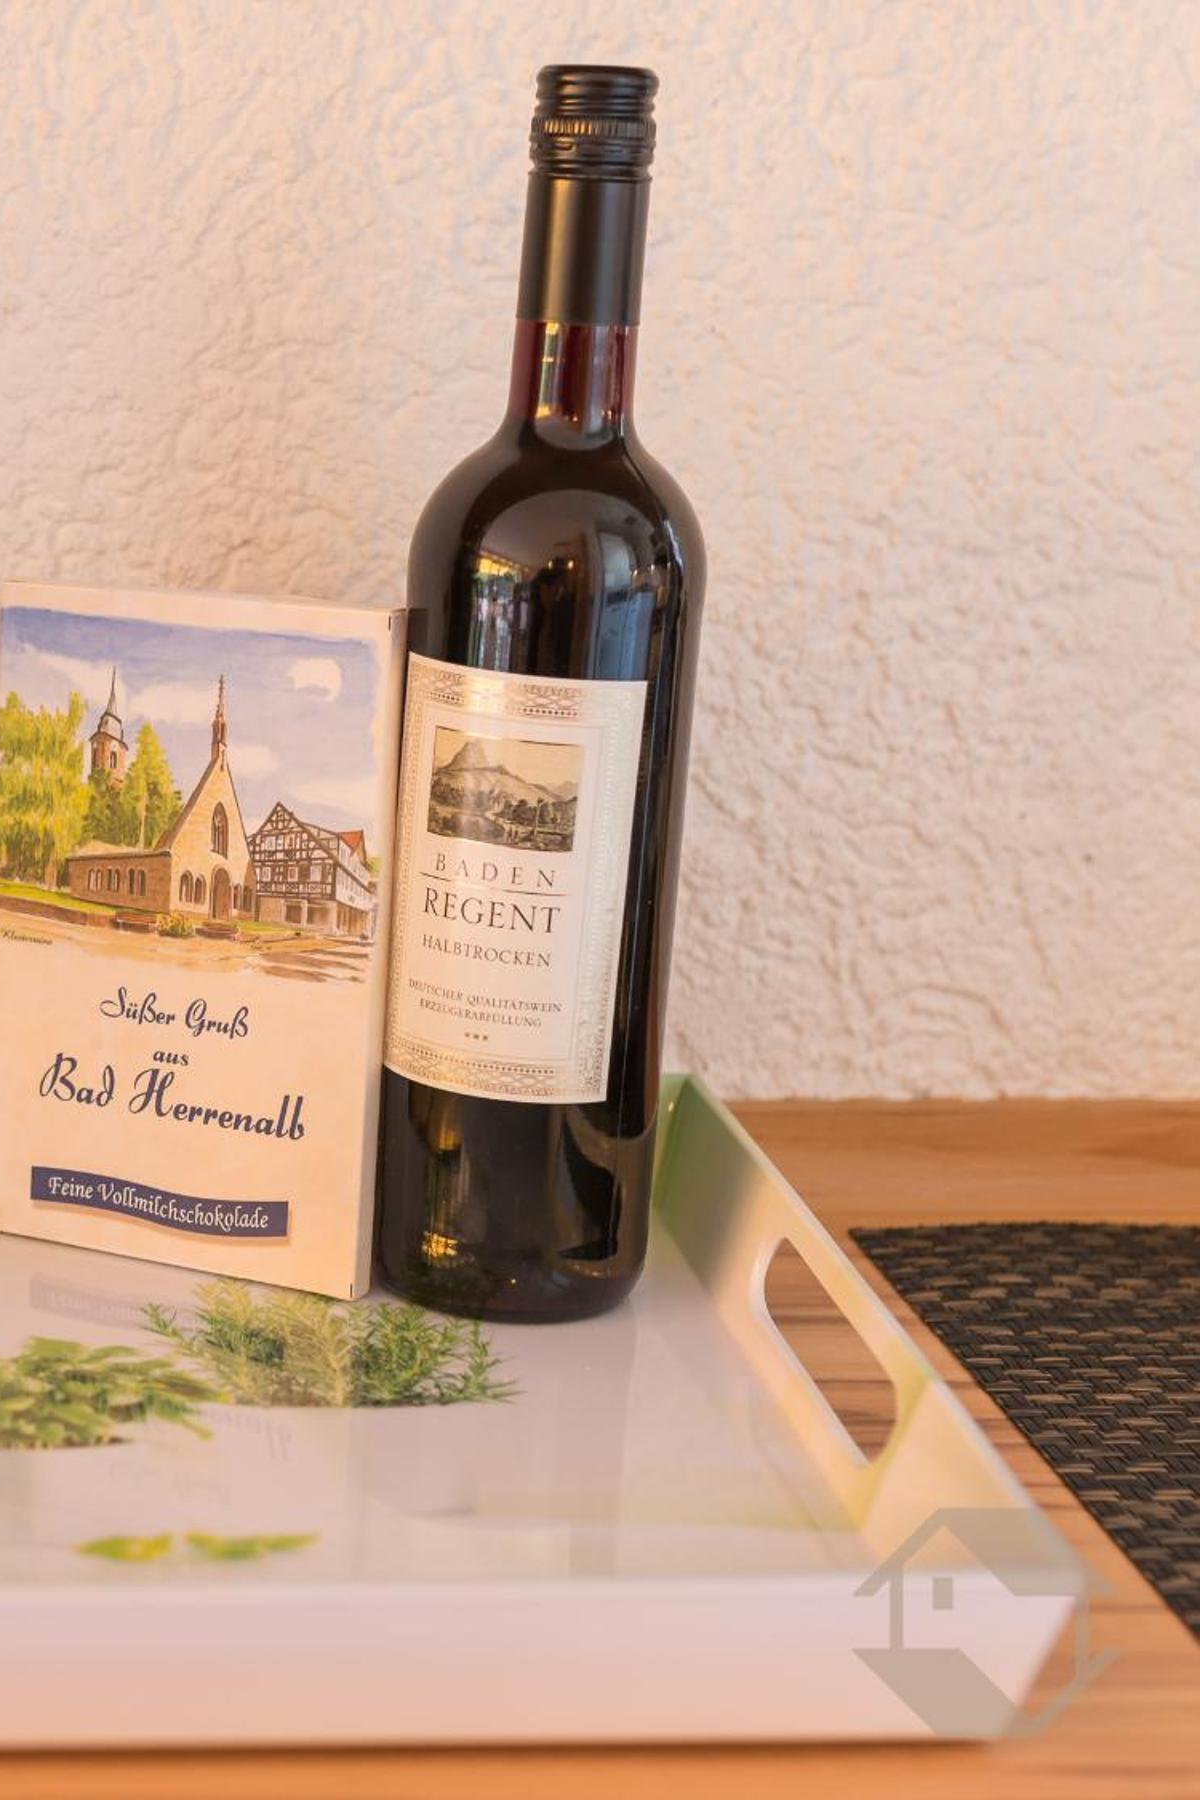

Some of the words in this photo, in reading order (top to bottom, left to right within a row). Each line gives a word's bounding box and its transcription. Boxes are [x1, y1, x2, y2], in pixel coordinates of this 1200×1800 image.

[435, 853, 556, 888] BADEN
[423, 886, 561, 934] REGENT
[422, 934, 551, 967] HALBTROCKEN
[99, 986, 176, 1026] Süßer
[184, 998, 249, 1039] Gruß
[152, 1047, 190, 1067] aus
[39, 1051, 115, 1108] Bad
[127, 1065, 305, 1140] Herrenalb
[47, 1175, 94, 1200] Feine
[96, 1182, 269, 1233] Vollmilchschokolade
